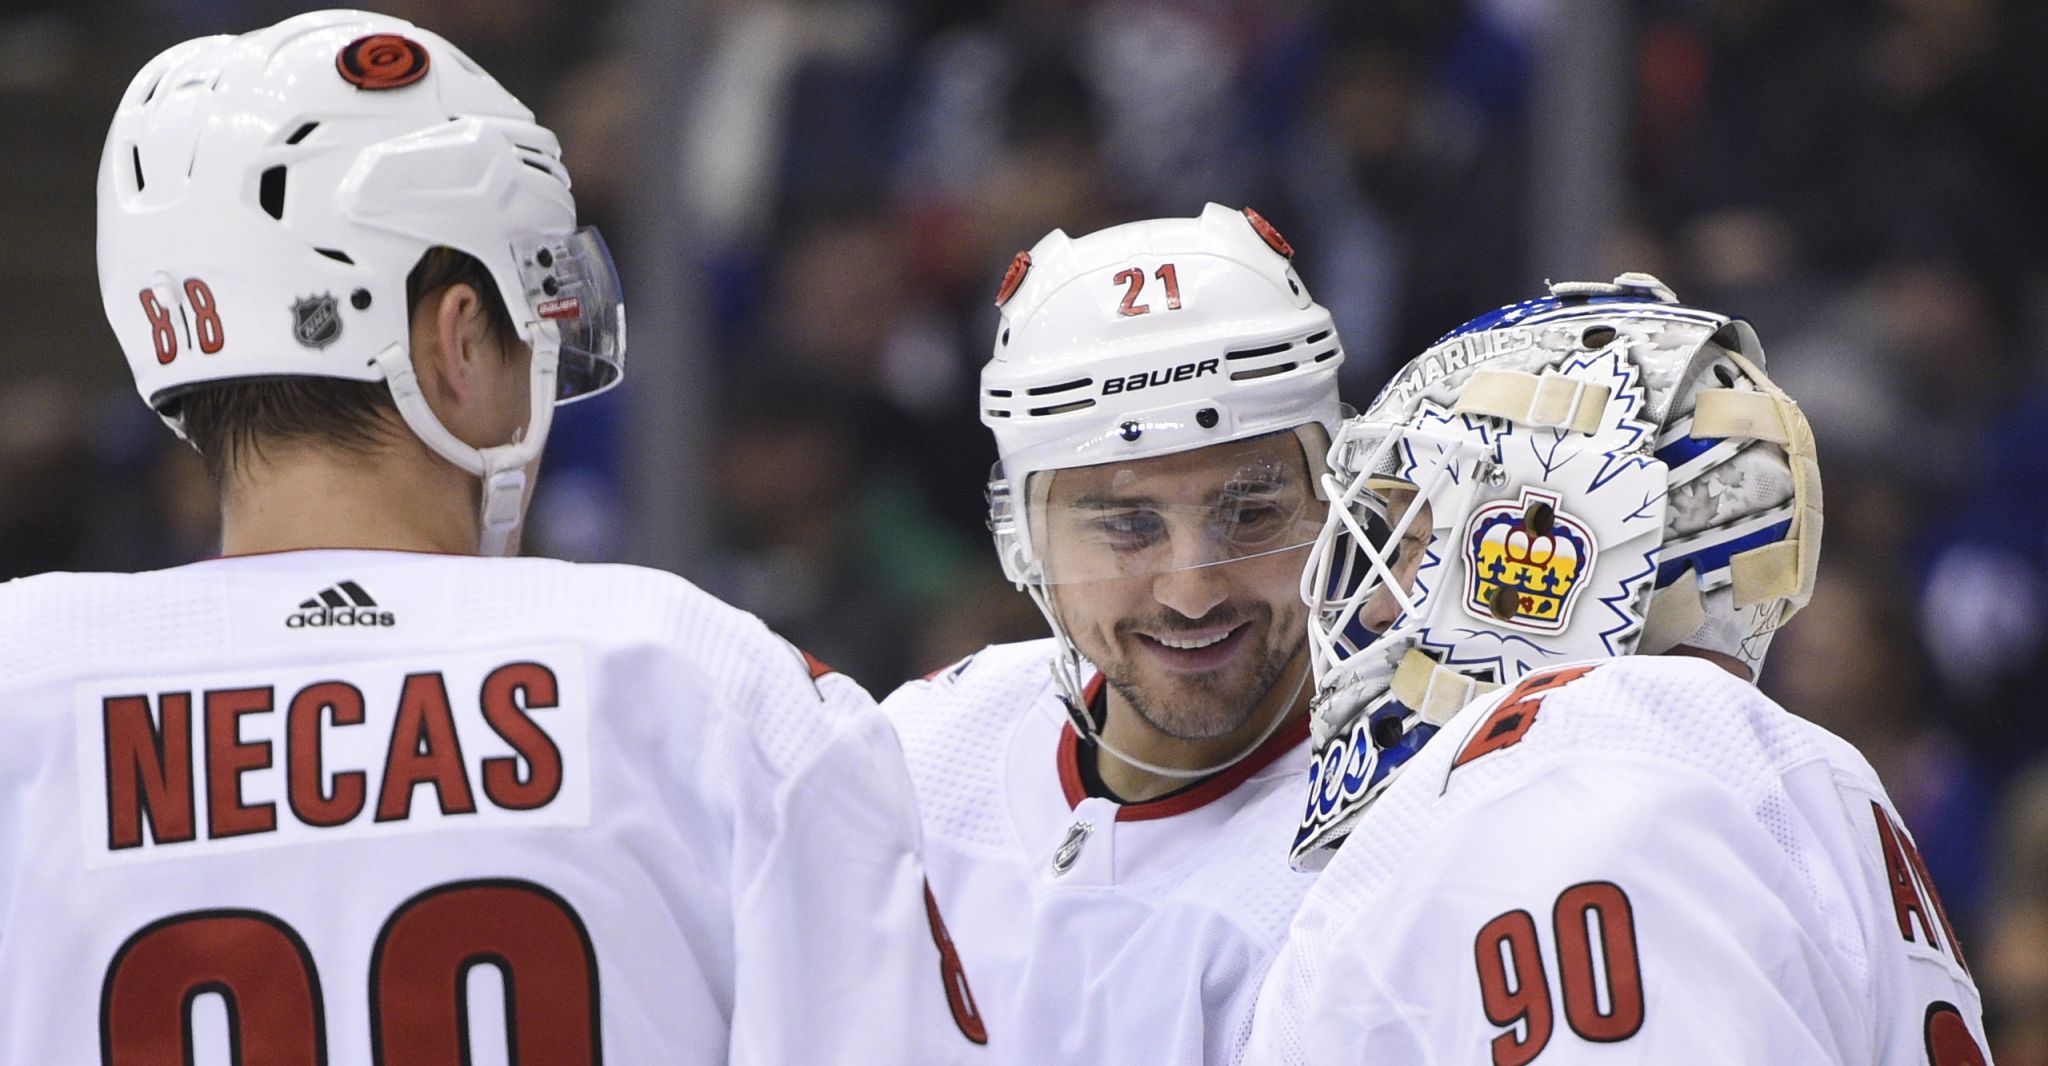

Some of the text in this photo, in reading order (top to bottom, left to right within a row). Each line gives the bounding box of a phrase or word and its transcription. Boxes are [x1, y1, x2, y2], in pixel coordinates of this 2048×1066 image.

[138, 276, 225, 366] 88
[1113, 263, 1182, 316] 21
[1101, 357, 1219, 396] BAUER
[1398, 329, 1534, 402] MARLIES
[285, 606, 396, 629] adidas
[102, 661, 563, 851] NECAS
[1474, 880, 1645, 1066] 90
